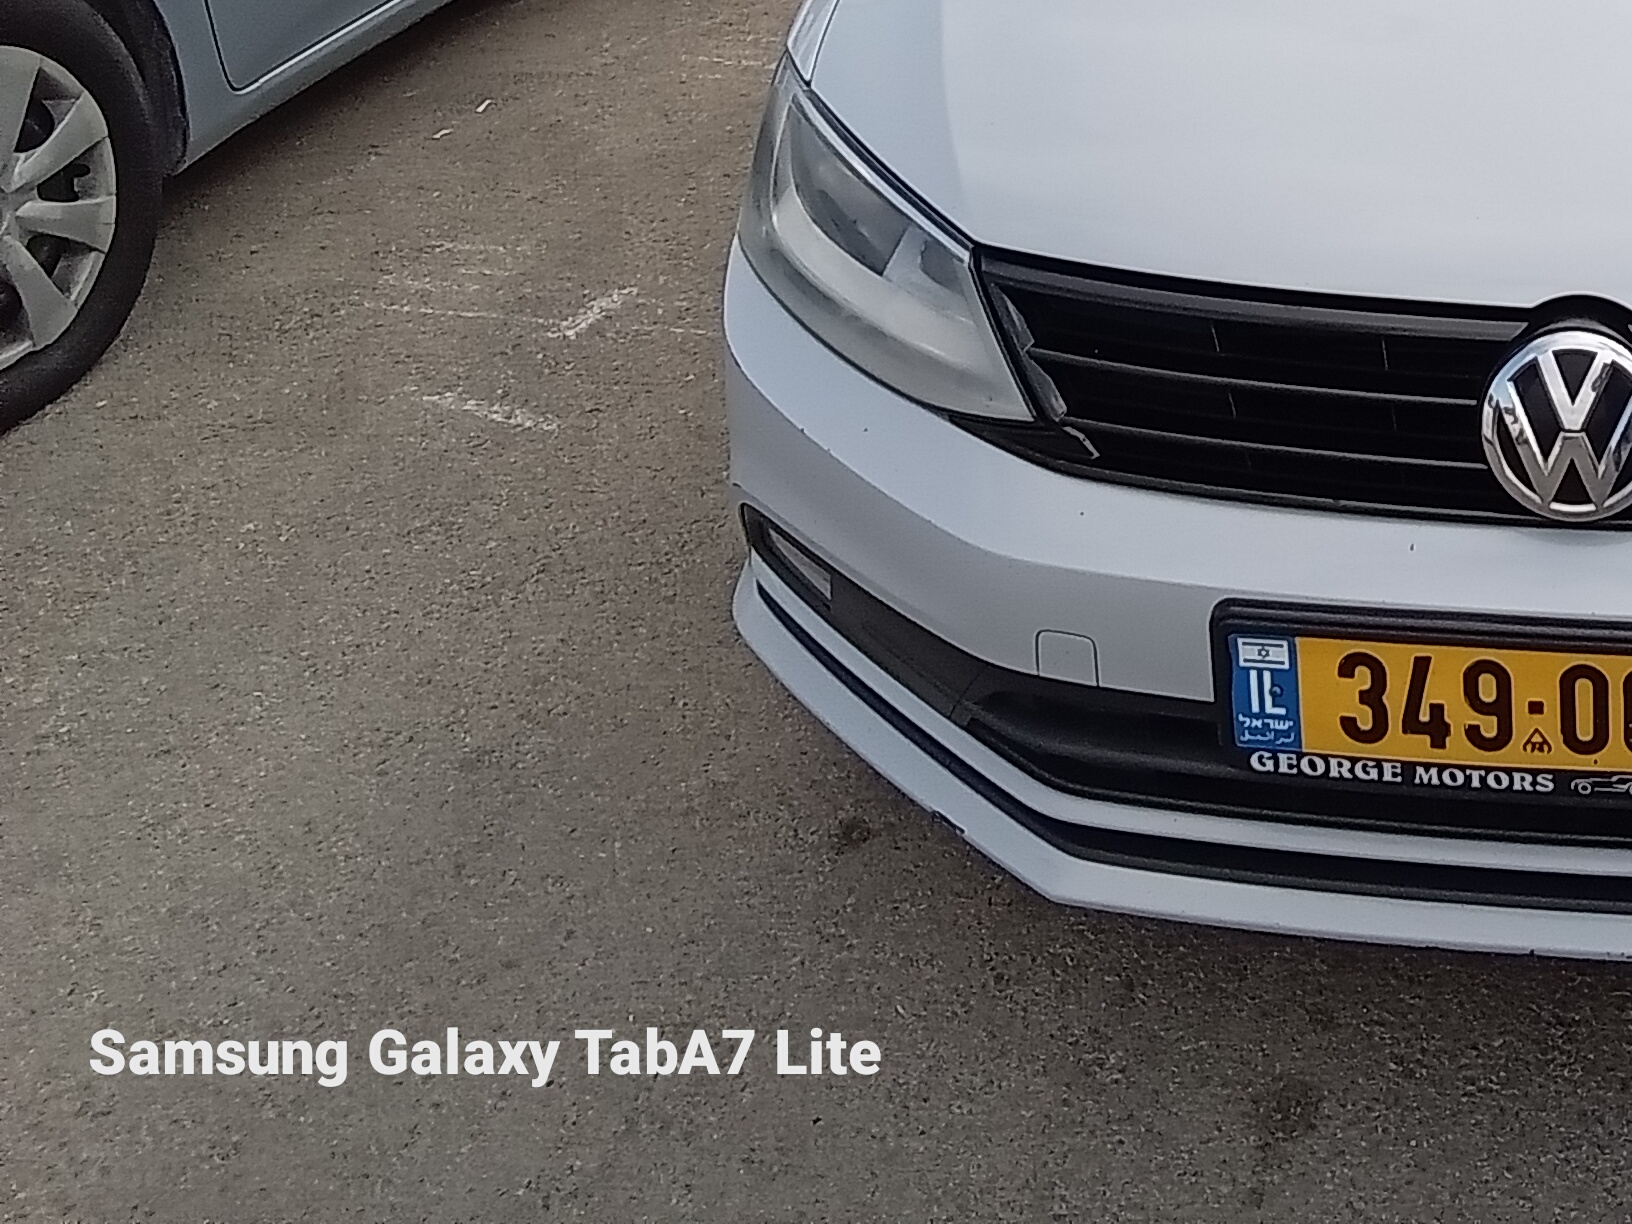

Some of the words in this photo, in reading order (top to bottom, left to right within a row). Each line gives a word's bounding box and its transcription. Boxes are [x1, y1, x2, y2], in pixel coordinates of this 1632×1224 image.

[1249, 669, 1287, 715] IL
[1238, 713, 1294, 730] ישראל
[1249, 749, 1403, 783] GEORGE
[1413, 765, 1556, 795] MOTORS
